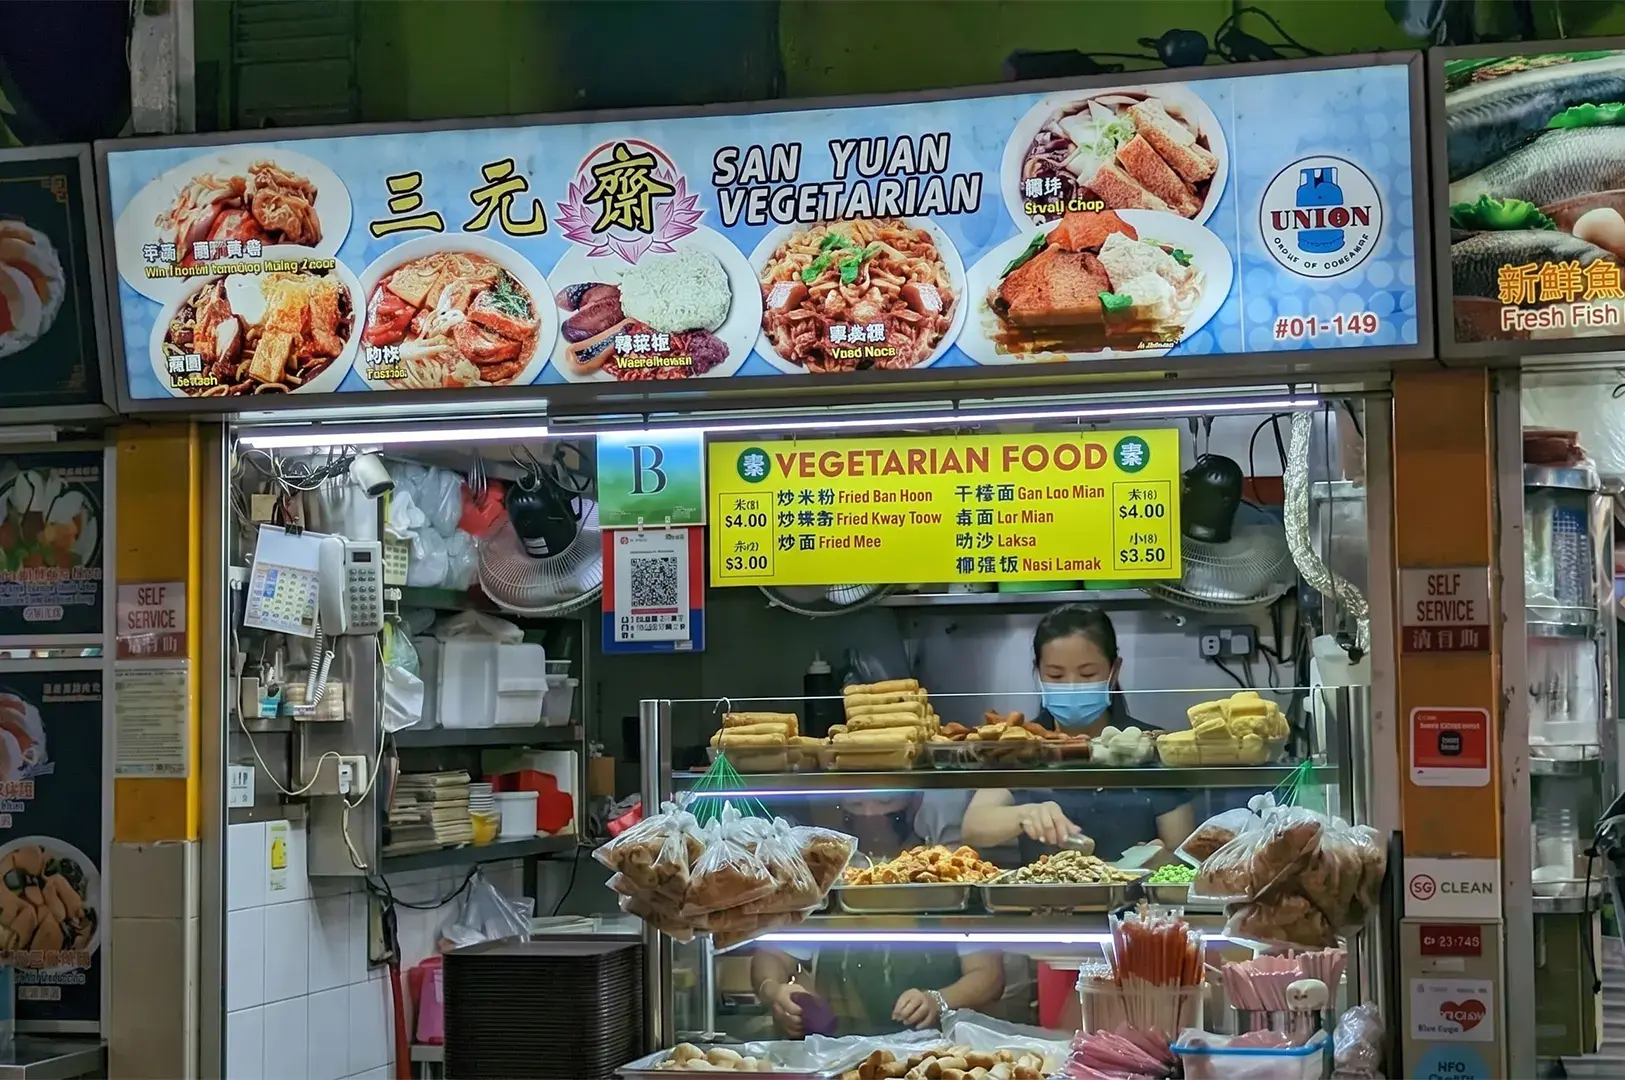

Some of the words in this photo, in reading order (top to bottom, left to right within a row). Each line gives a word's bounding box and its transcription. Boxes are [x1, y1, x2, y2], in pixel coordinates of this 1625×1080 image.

[711, 141, 801, 186] SAN
[829, 133, 950, 178] YUAN
[717, 172, 983, 228] VEGETARIAN
[1270, 206, 1371, 231] UNION
[1498, 258, 1625, 305] 新鮮魚
[1275, 314, 1377, 338] #01-149
[1502, 303, 1565, 331] Fresh
[1572, 303, 1618, 326] Fish
[626, 444, 668, 495] B
[775, 446, 990, 478] VEGETARIAN
[1002, 443, 1108, 472] FOOD
[777, 488, 835, 506] 炒米粉
[838, 490, 870, 503] Fried
[873, 489, 896, 503] Ban
[900, 488, 932, 502] Hoon
[1018, 487, 1043, 500] Gan
[1072, 485, 1105, 498] Mian
[725, 513, 767, 528] $4.00
[837, 512, 868, 525] Fried
[872, 511, 905, 527] Kway
[909, 511, 942, 524] Toow
[1021, 510, 1054, 523] Mian
[1119, 504, 1165, 519] $4.00
[778, 534, 816, 551] 炒面
[819, 535, 850, 548] Fried
[854, 535, 881, 548] Mee
[998, 533, 1036, 547] Laksa
[725, 555, 768, 571] $3.00
[1023, 558, 1052, 571] Nasi
[1056, 557, 1102, 571] Lamak
[1120, 548, 1165, 563] $3.50
[1428, 574, 1461, 596] SELF
[138, 587, 166, 606] SELF
[128, 610, 176, 629] SERVICE
[1417, 600, 1475, 621] SERVICE
[1414, 882, 1433, 893] SG
[1441, 882, 1493, 893] CLEAN
